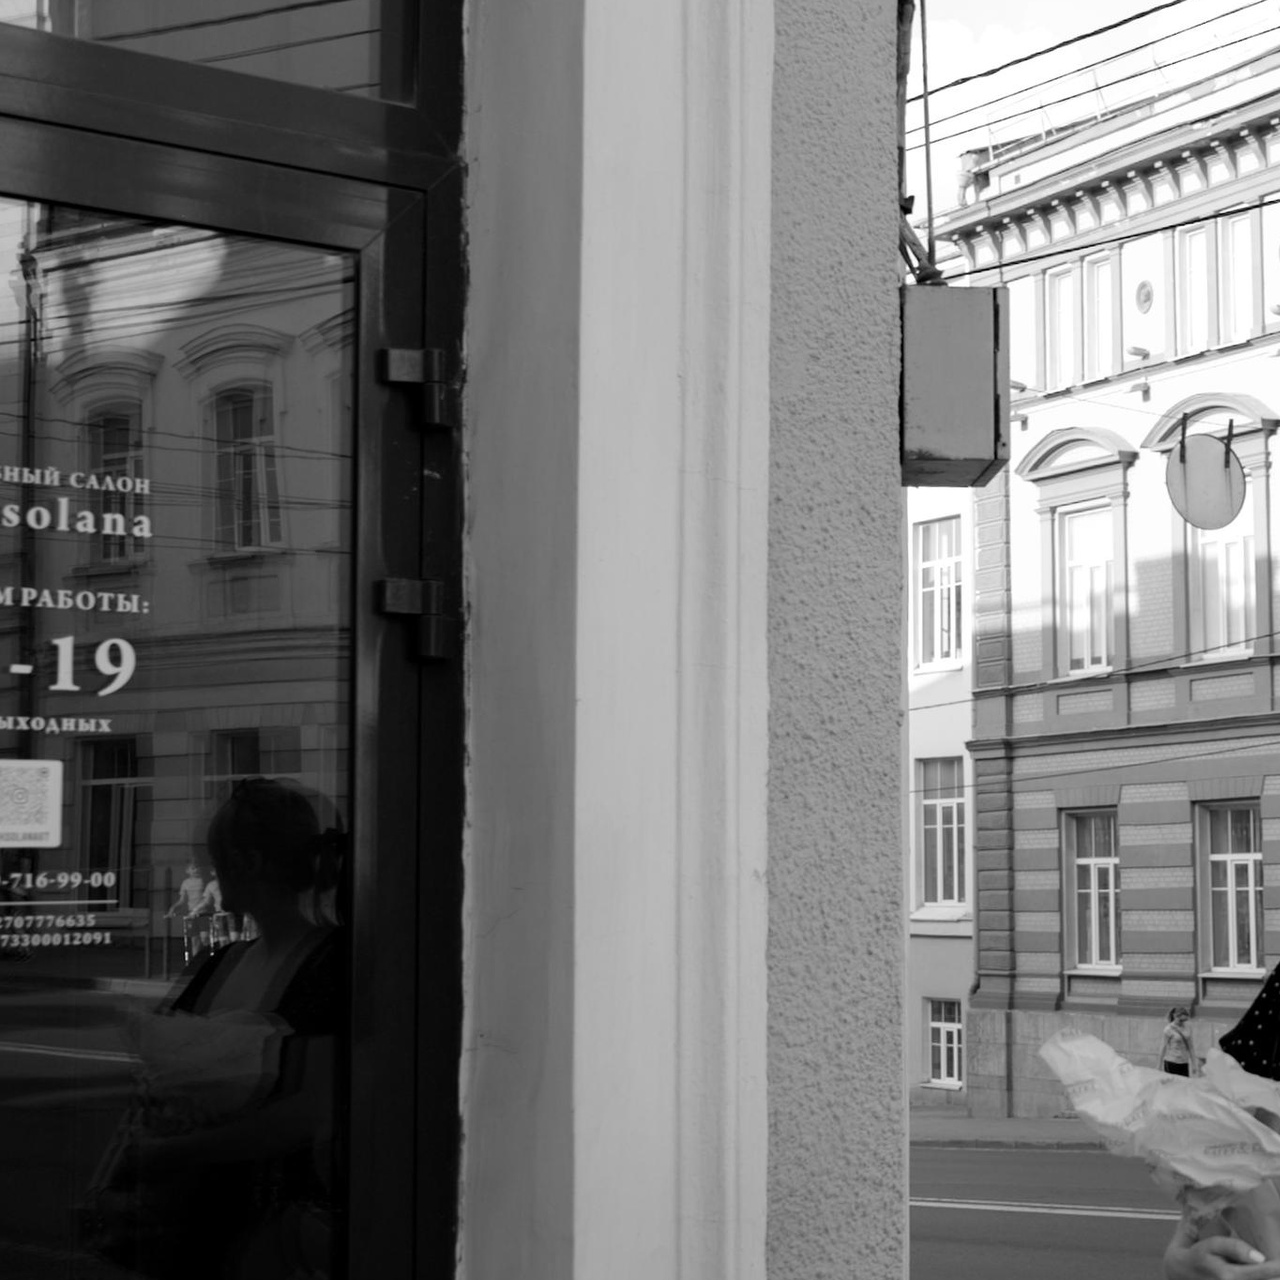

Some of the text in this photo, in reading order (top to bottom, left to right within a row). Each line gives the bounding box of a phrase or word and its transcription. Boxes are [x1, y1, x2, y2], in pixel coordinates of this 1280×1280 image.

[0, 466, 150, 494] НЫЙ САЛОН
[2, 497, 153, 538] solana
[20, 587, 149, 613] РАБОТЫ:
[0, 871, 116, 889] -716-99-00
[0, 914, 96, 929] 707776635
